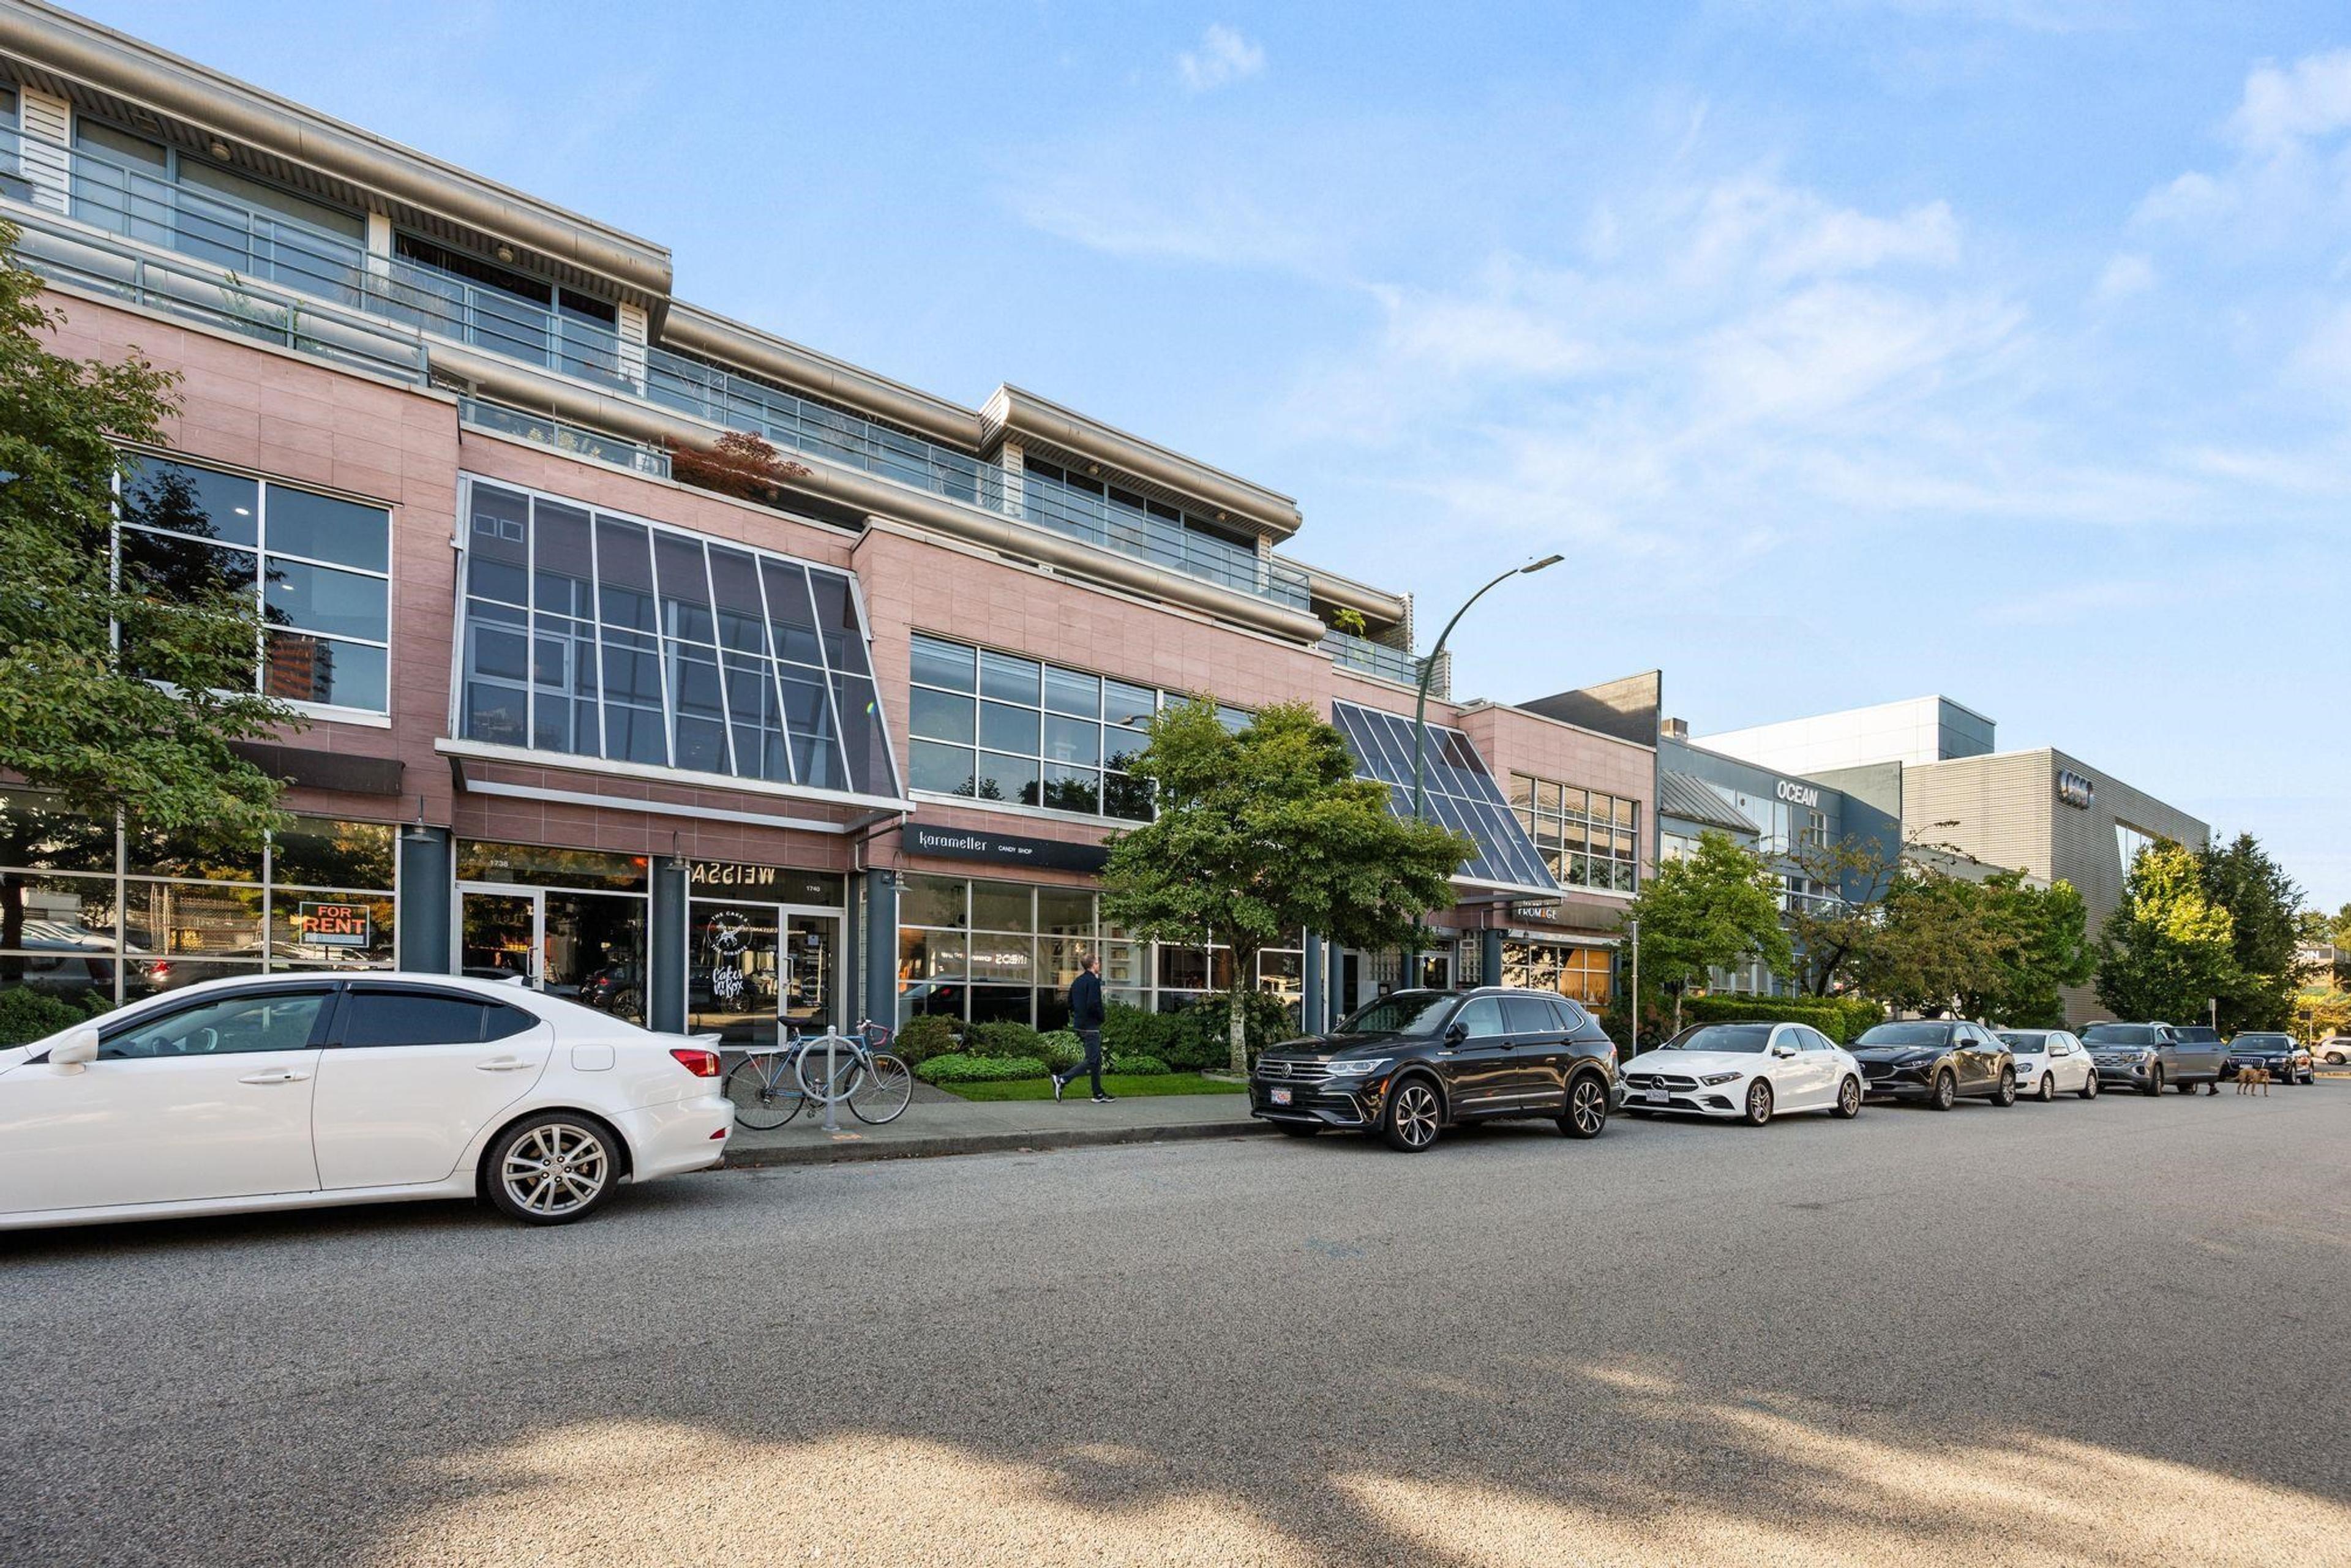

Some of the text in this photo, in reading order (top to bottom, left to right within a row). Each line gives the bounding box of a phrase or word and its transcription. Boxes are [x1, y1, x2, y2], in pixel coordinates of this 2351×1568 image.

[1777, 781, 1818, 808] OCEAN
[919, 831, 988, 851] karameller
[318, 906, 352, 918] FOR
[302, 917, 366, 934] RENT
[713, 965, 743, 983] Cakes
[726, 978, 744, 999] Box
